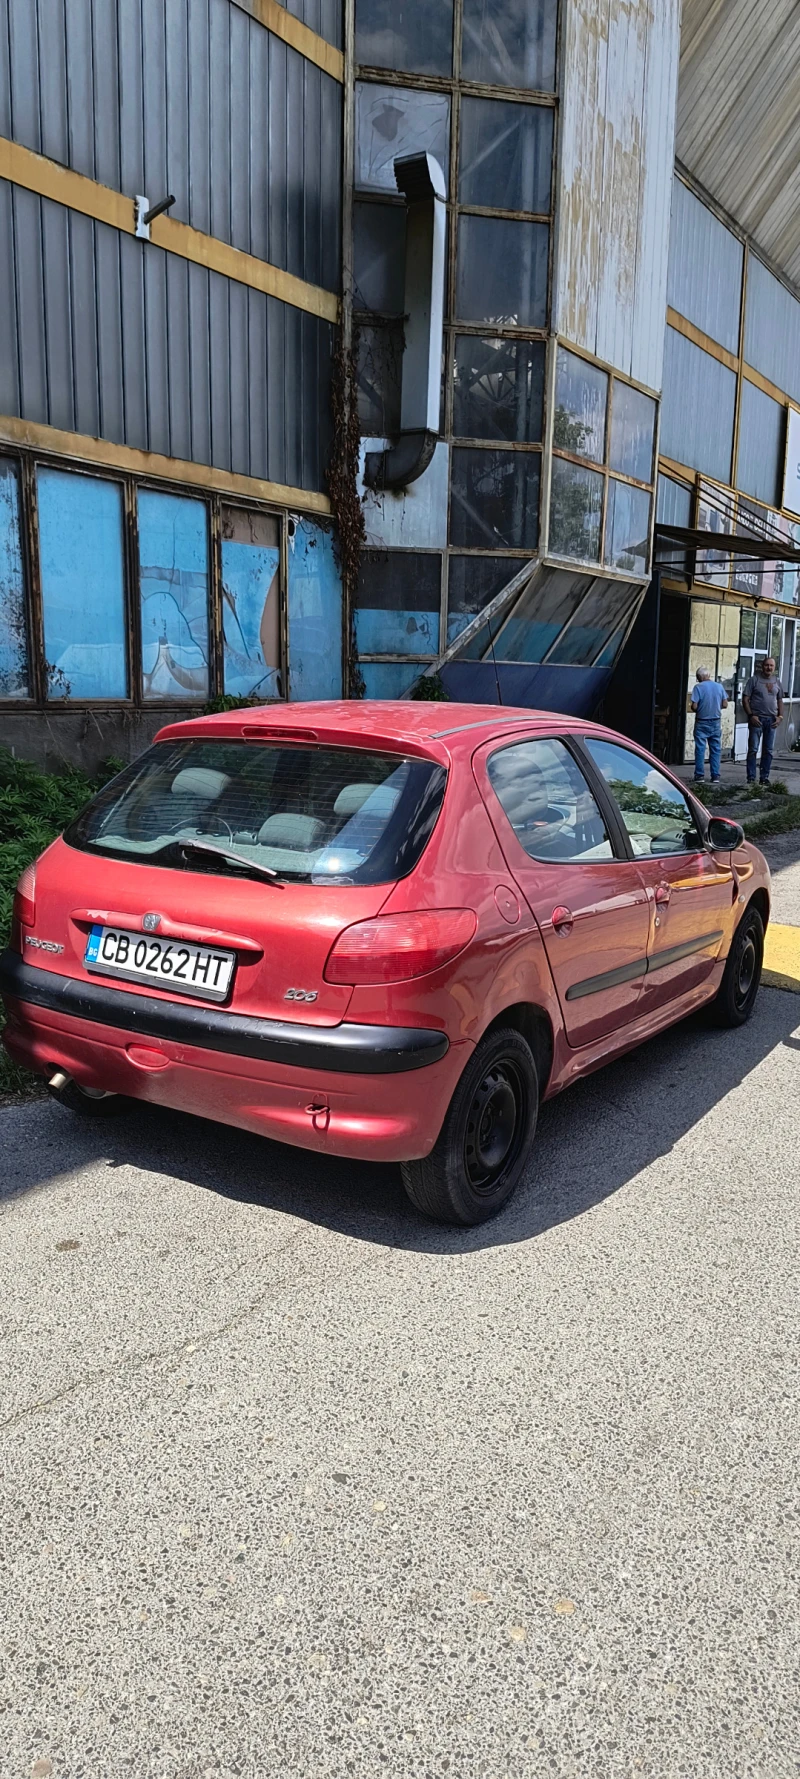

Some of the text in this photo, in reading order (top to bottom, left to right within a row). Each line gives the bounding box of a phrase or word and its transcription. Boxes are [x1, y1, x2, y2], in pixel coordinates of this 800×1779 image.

[25, 935, 64, 954] PEUGEOT
[88, 946, 98, 957] BG
[102, 932, 228, 986] CB 0262 HT
[284, 988, 319, 1003] 206
